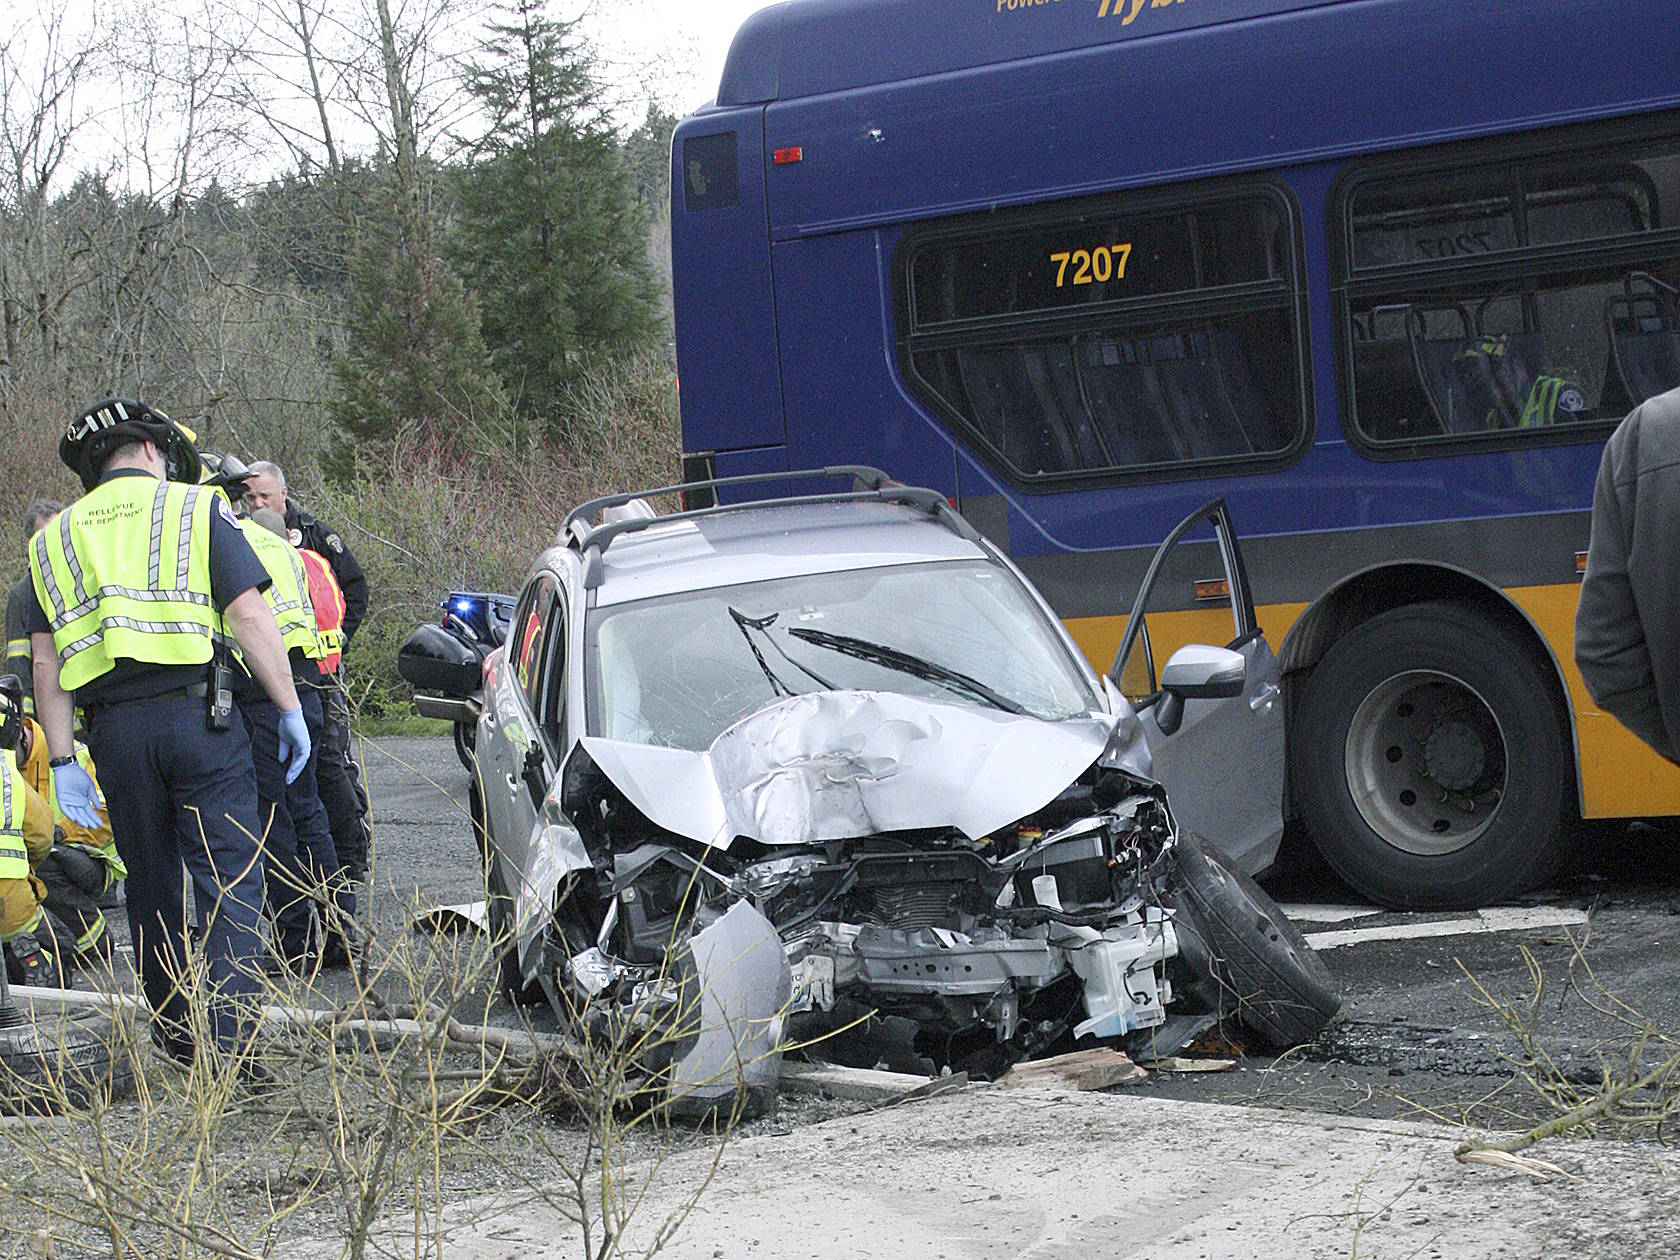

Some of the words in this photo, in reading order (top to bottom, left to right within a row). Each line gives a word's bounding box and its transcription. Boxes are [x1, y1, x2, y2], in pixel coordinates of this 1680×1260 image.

[1050, 242, 1132, 288] 7207
[88, 502, 135, 516] BELLEVUE
[96, 507, 143, 525] DEPARTMENT
